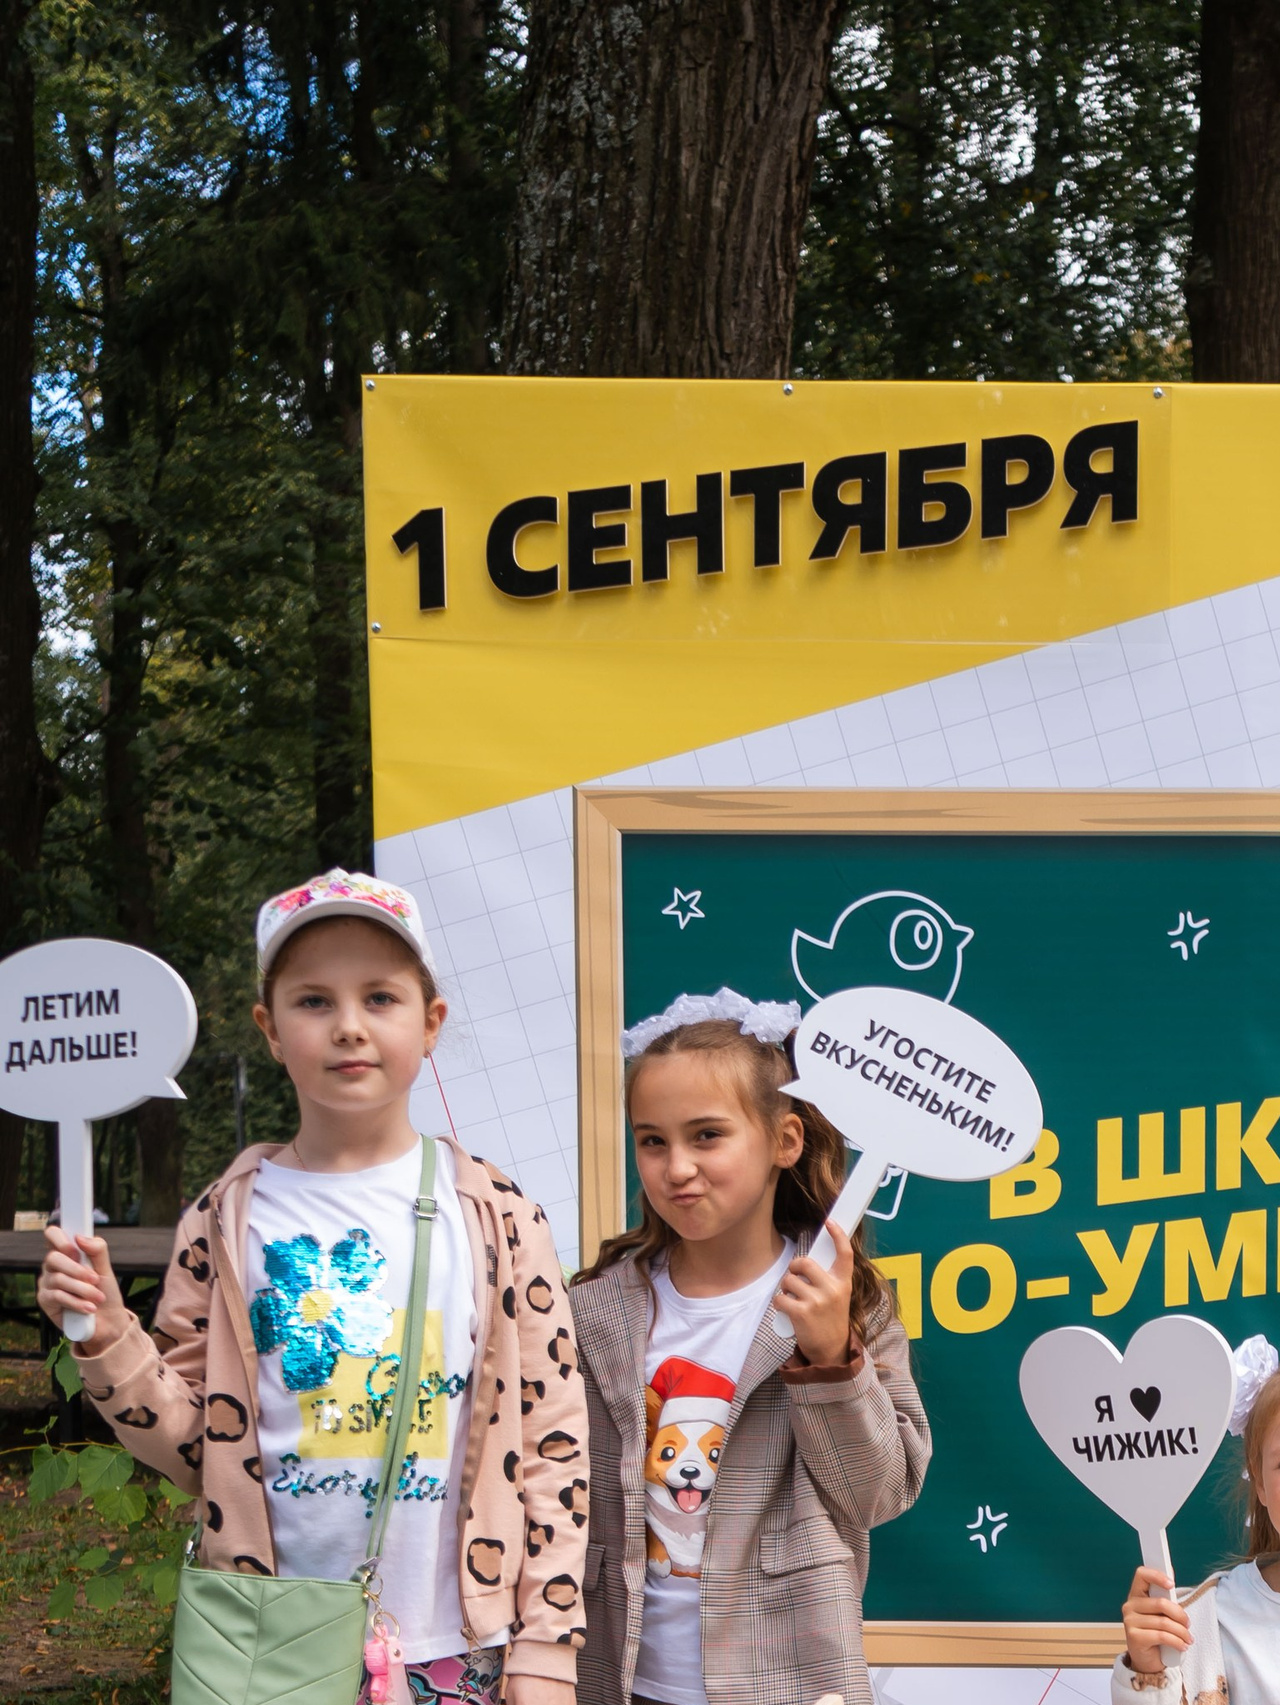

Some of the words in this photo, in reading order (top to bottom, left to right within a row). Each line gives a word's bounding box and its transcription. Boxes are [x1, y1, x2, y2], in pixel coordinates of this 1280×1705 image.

[391, 507, 447, 612] 1
[485, 420, 1139, 600] СЕНТЯБРЯ
[21, 989, 120, 1023] ЛЕТИМ
[5, 1028, 139, 1073] ДАЛЬШЕ!
[863, 1018, 996, 1104] УГОСТИТЕ
[809, 1031, 1015, 1152] ВКУСНЕНЬКИМ!
[990, 1128, 1062, 1220] В
[1094, 1395, 1116, 1423] Я
[1071, 1427, 1200, 1464] ЧИЖИК!
